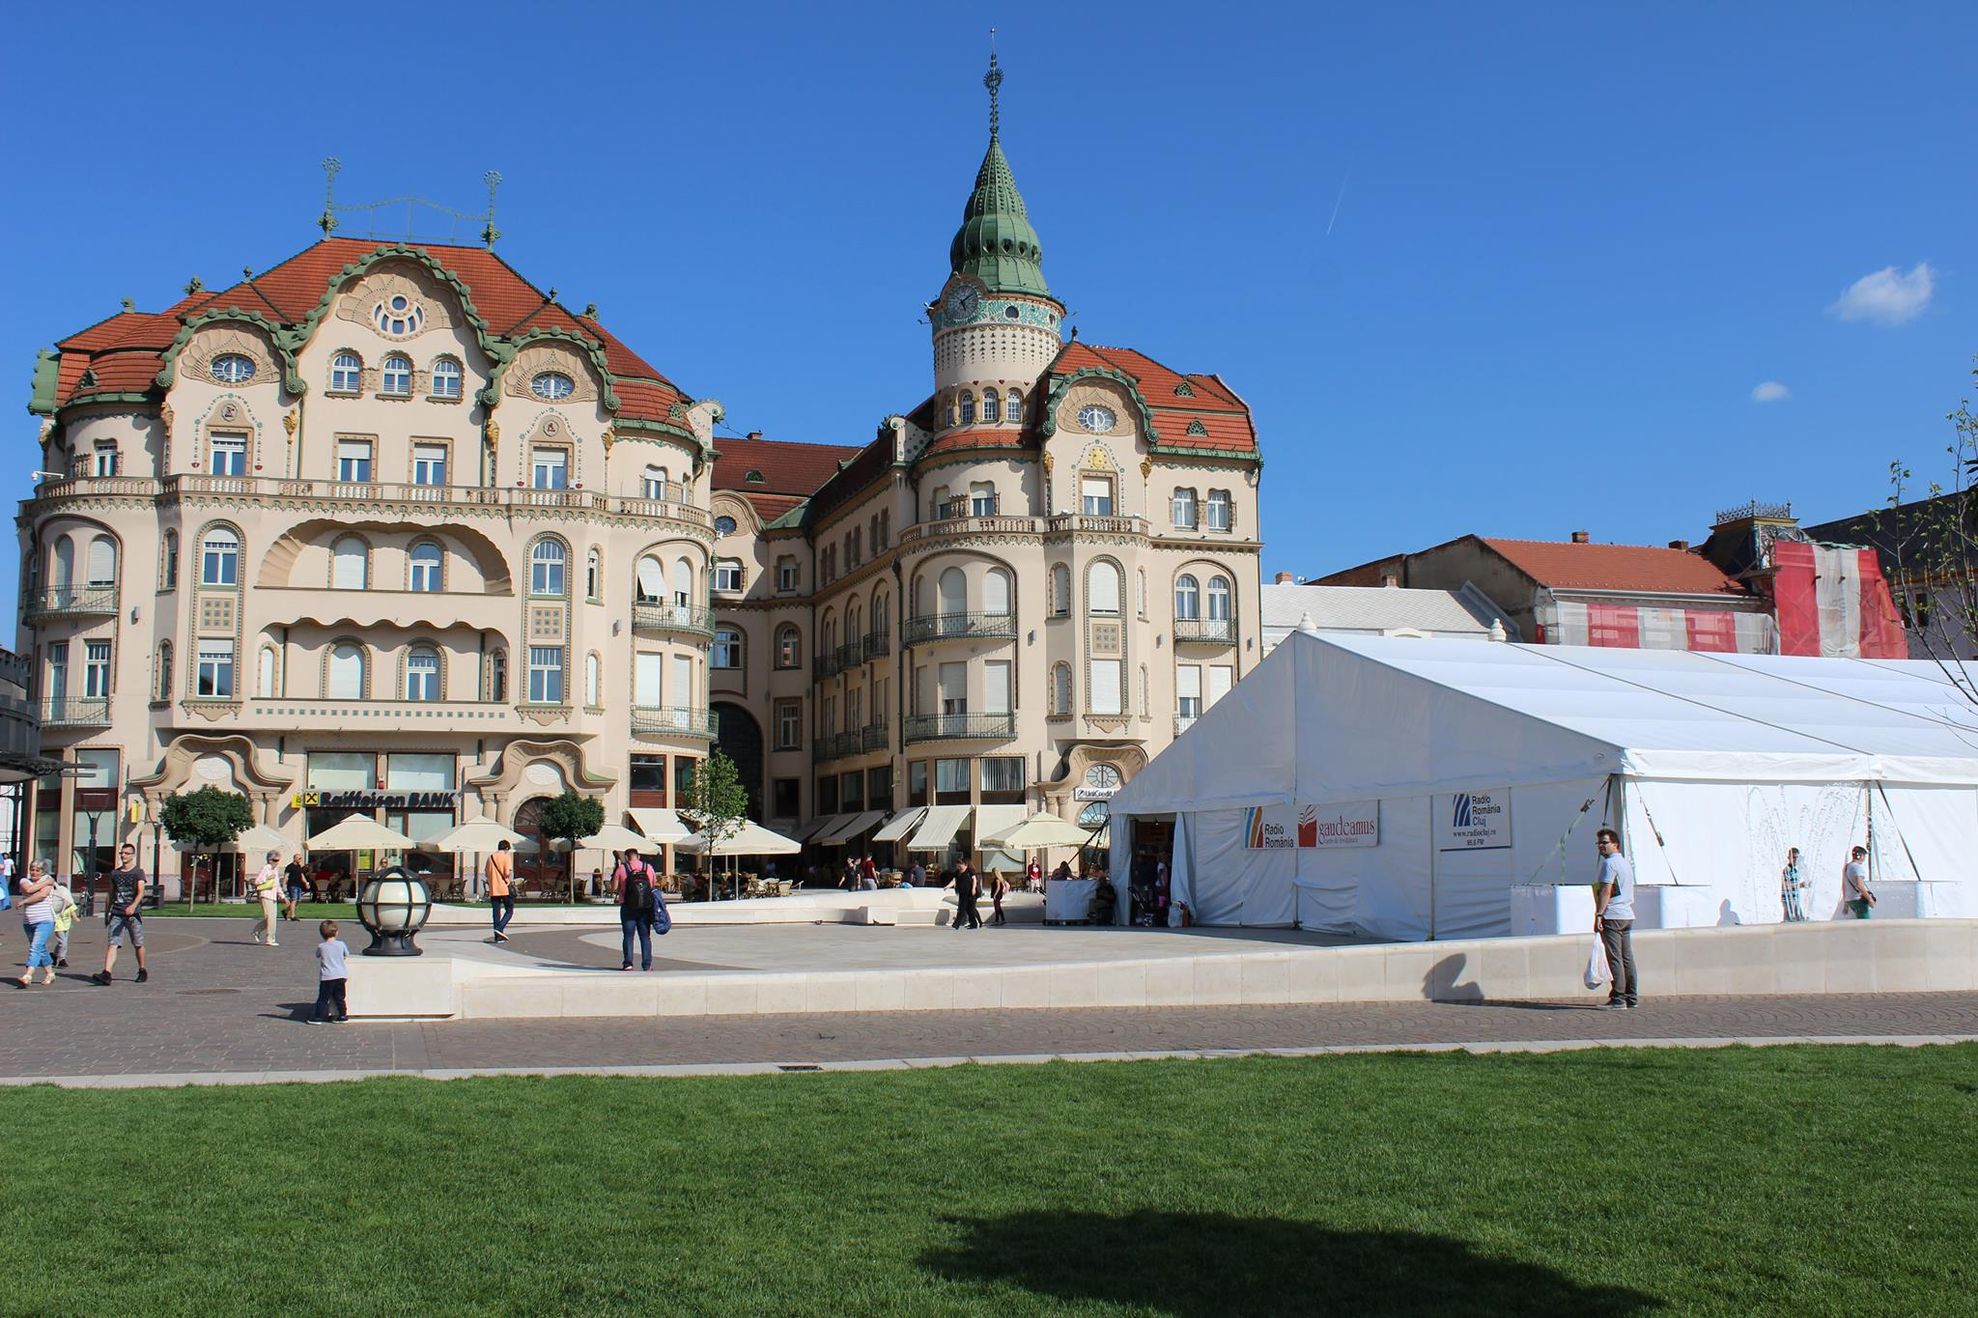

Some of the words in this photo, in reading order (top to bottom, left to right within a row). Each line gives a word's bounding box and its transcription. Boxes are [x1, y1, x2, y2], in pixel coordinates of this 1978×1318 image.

[320, 791, 405, 807] Raiffeisen
[408, 792, 455, 807] BANK
[1472, 795, 1491, 805] Radio
[1472, 804, 1501, 815] România
[1472, 816, 1486, 827] Cluj
[1264, 823, 1284, 835] Radio
[1318, 815, 1376, 844] gaudeamus
[1264, 836, 1294, 848] România
